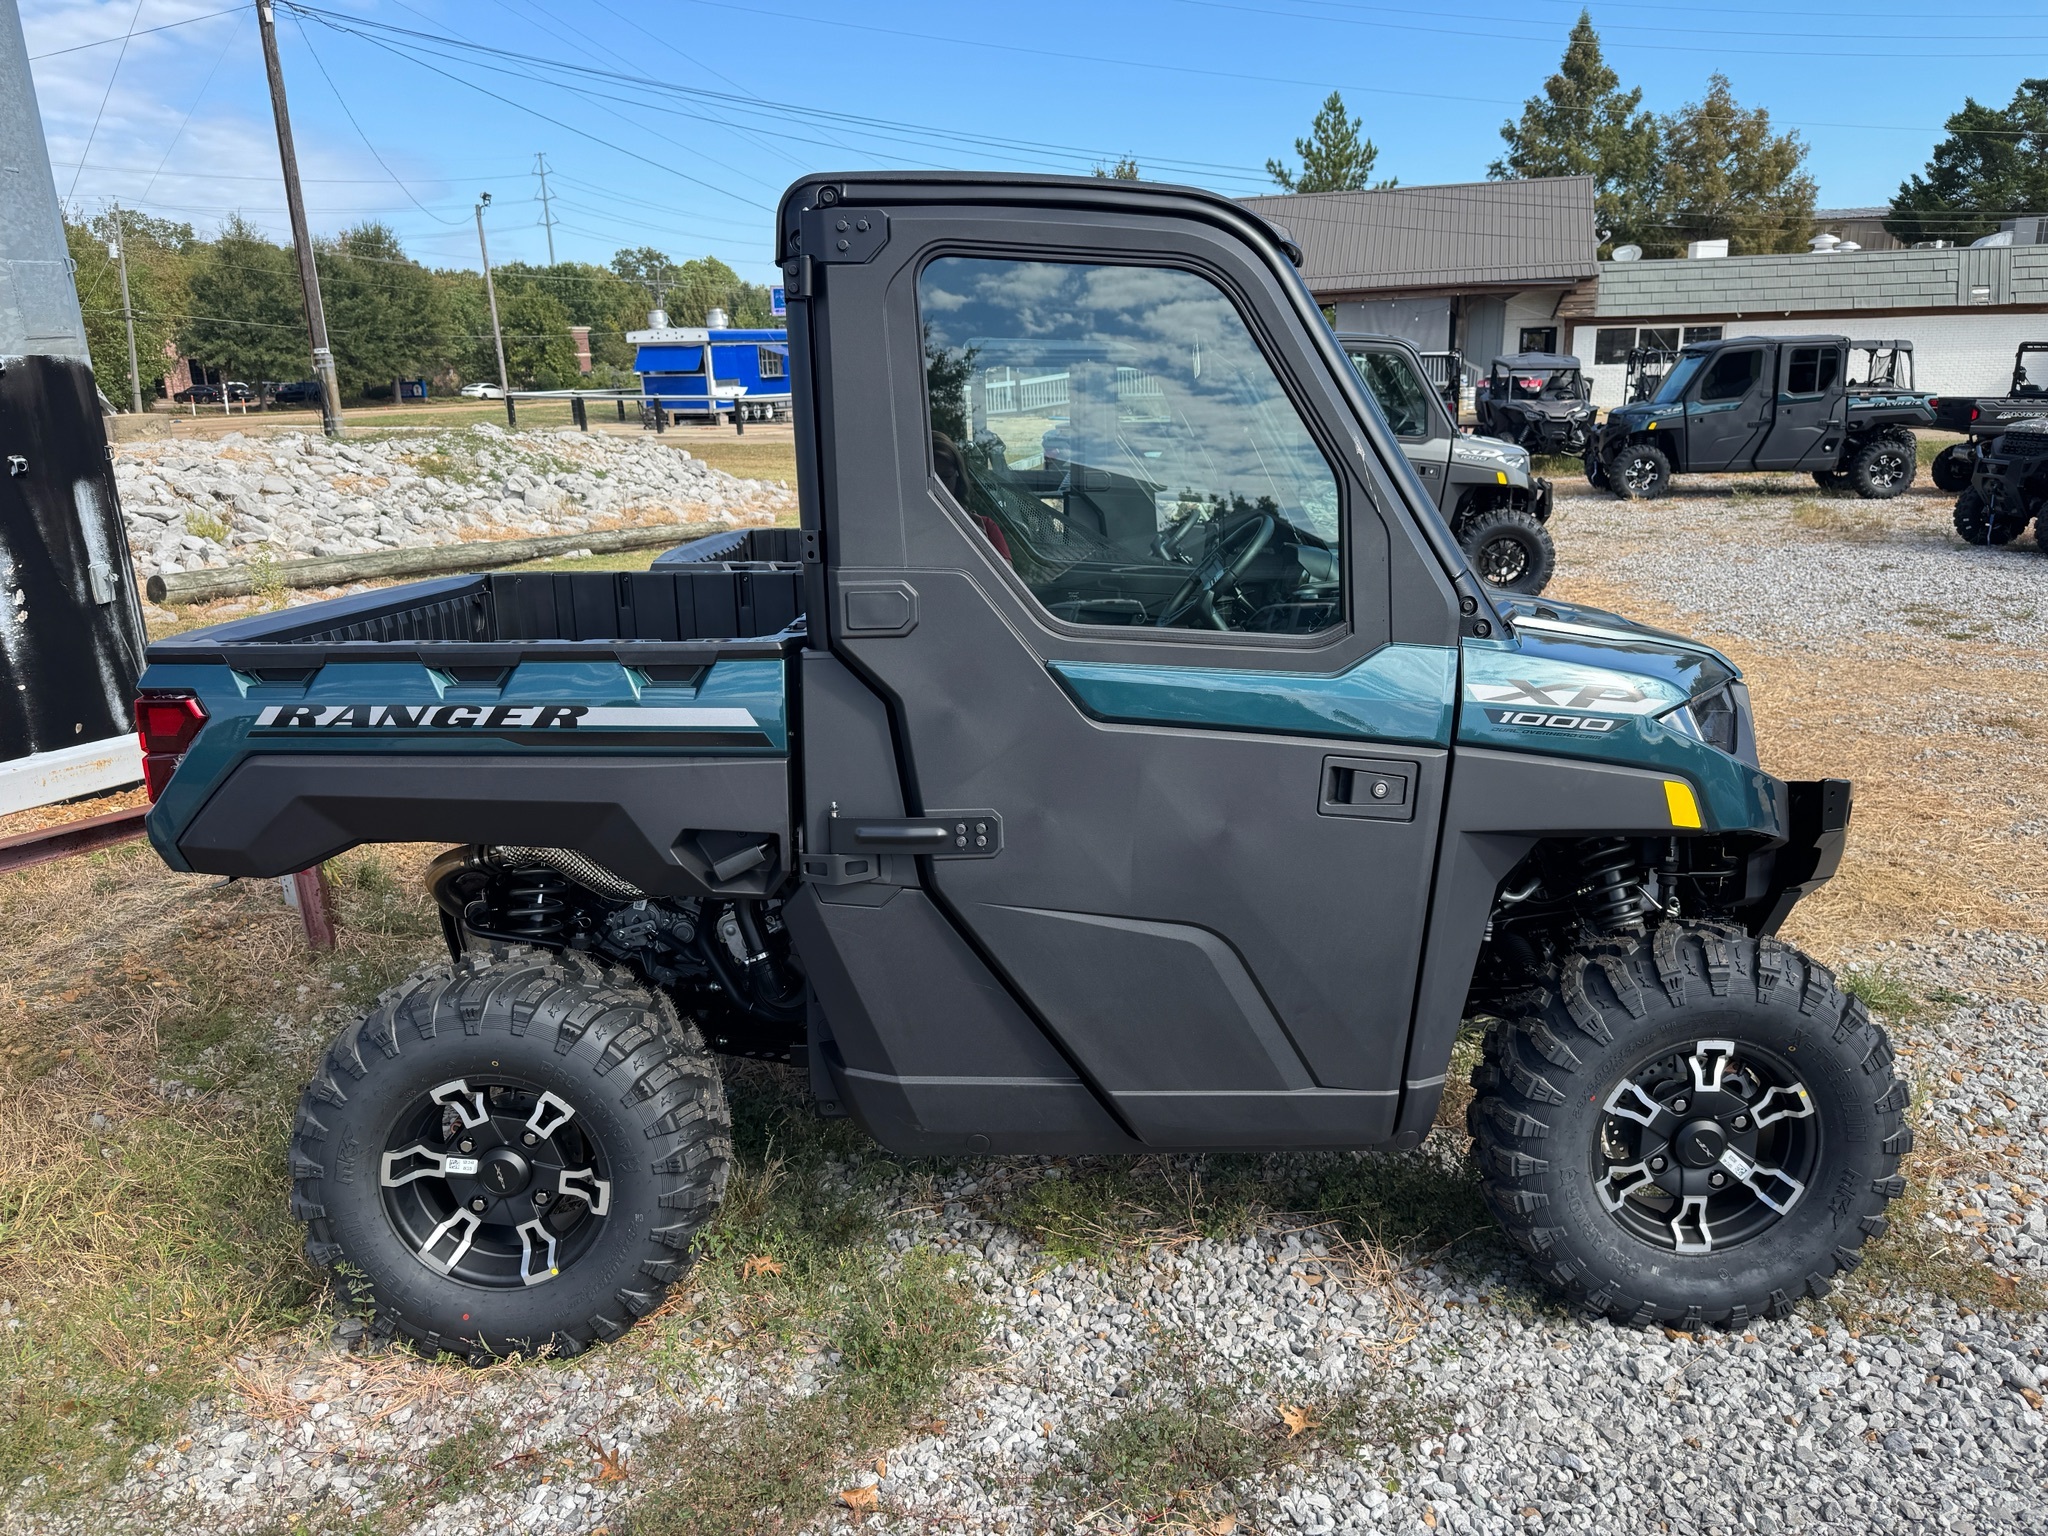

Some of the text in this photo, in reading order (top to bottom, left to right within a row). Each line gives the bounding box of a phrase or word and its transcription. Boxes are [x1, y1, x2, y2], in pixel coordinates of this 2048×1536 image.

[1459, 454, 1488, 462] 1000
[1483, 679, 1648, 708] XP
[270, 704, 590, 729] RANGER
[1499, 711, 1615, 732] 1000
[1521, 729, 1577, 738] OVERHEAD
